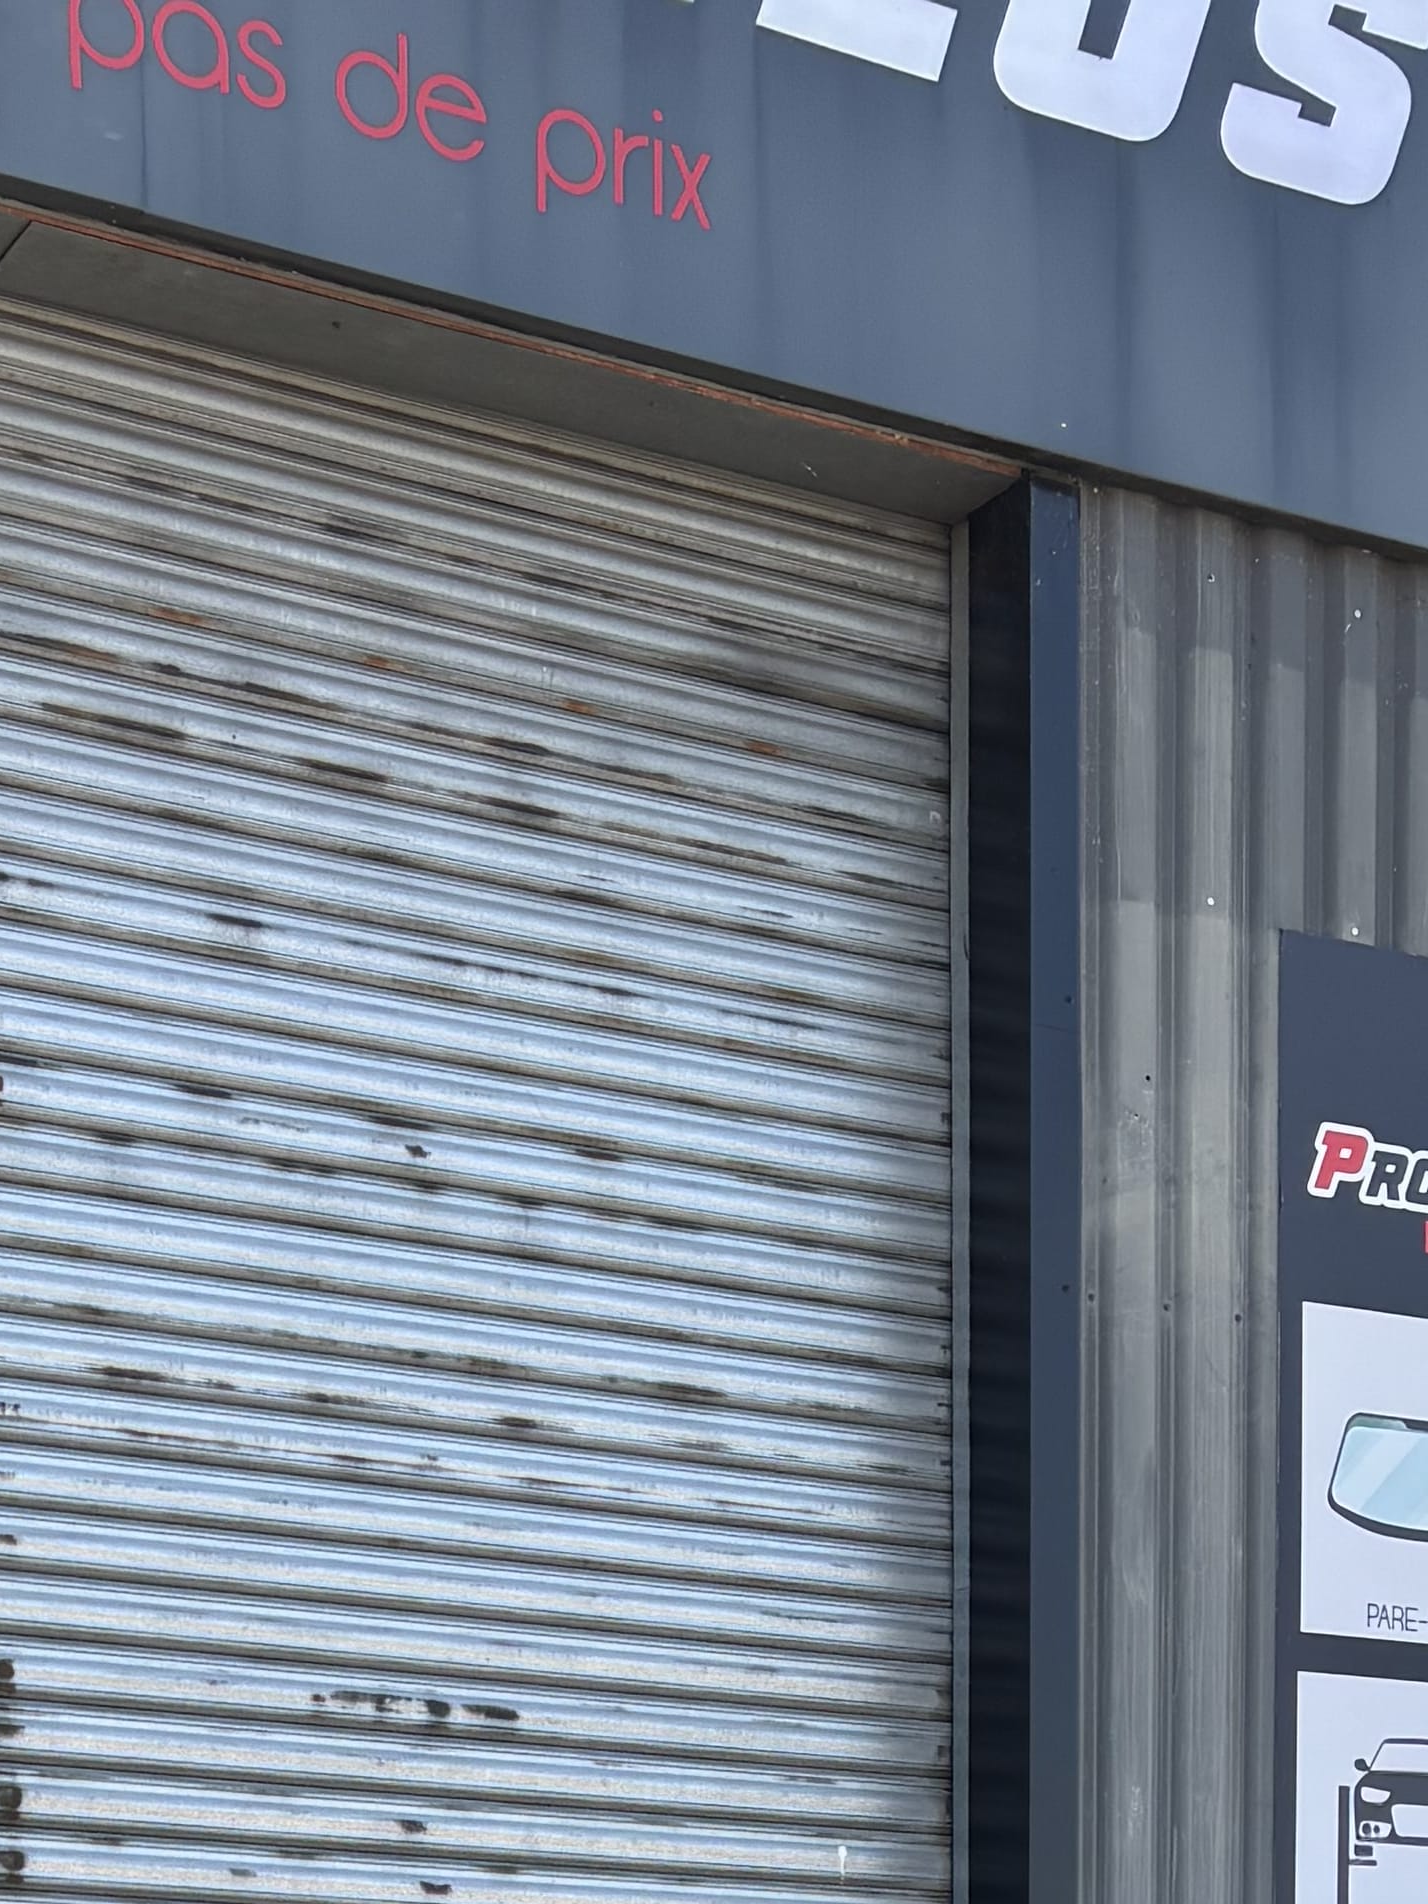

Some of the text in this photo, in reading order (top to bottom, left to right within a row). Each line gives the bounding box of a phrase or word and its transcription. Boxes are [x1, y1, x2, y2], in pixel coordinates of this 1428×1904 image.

[69, 0, 710, 230] pas de prix
